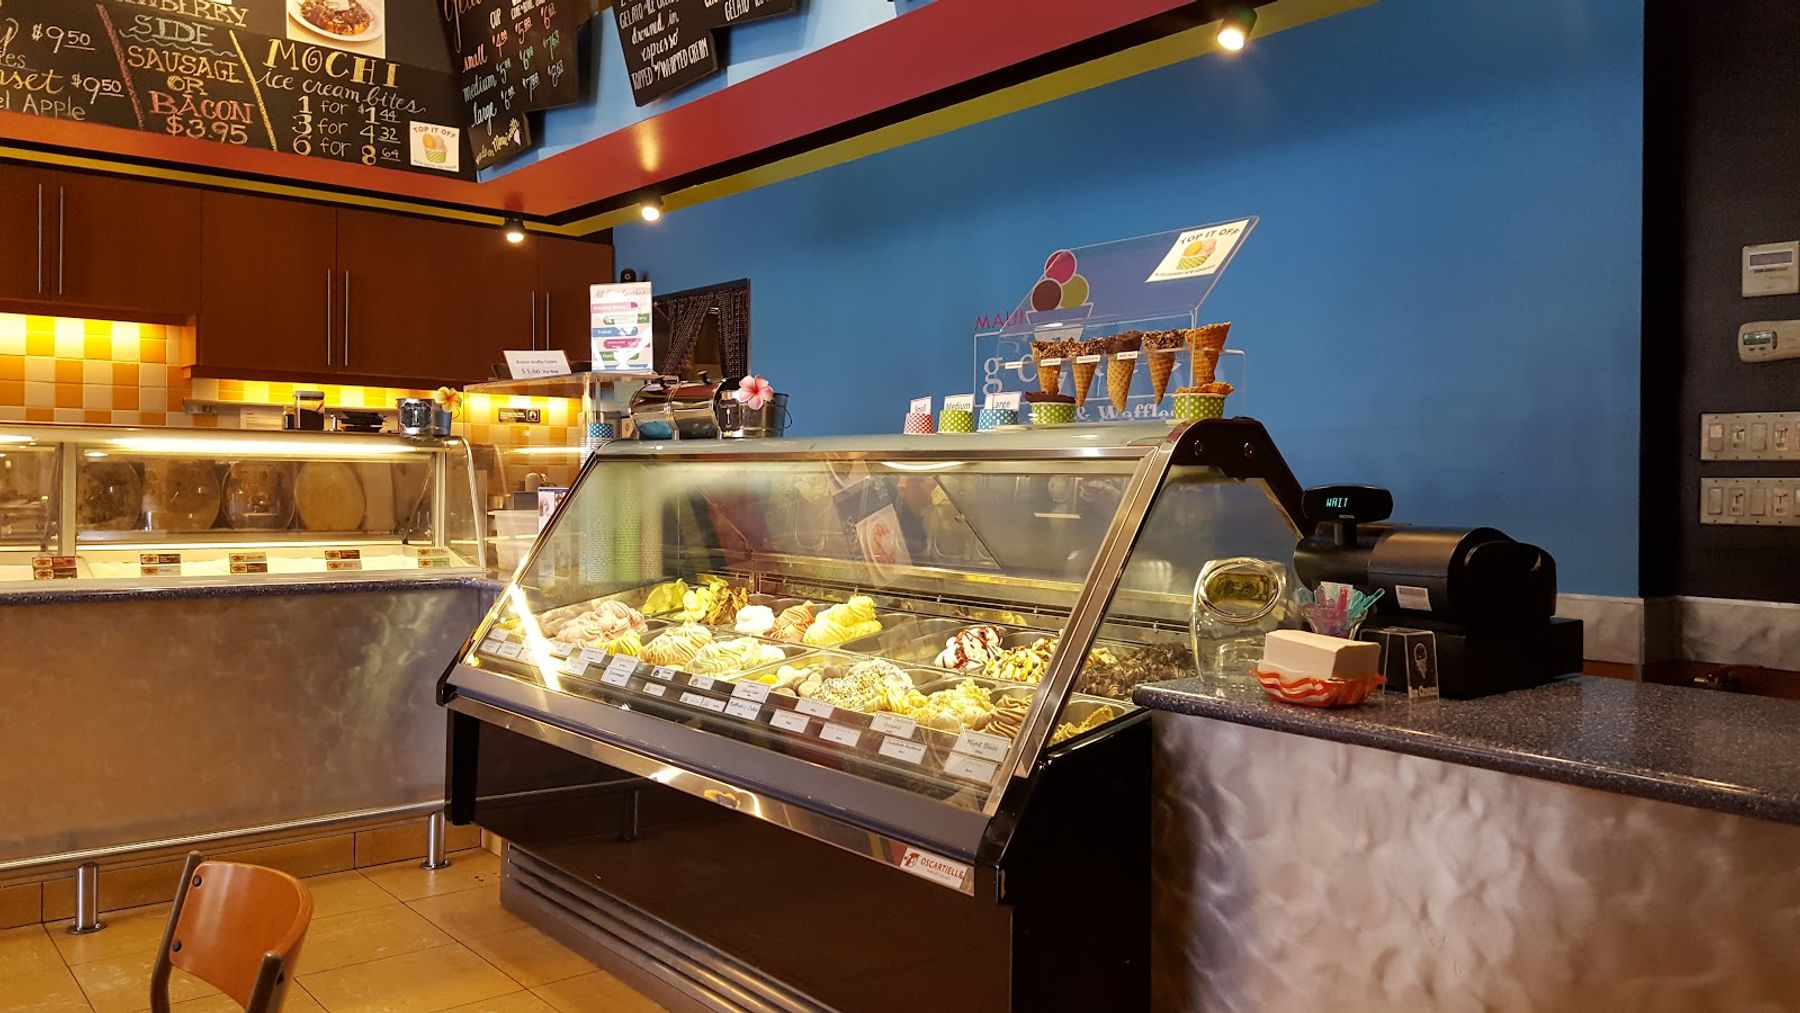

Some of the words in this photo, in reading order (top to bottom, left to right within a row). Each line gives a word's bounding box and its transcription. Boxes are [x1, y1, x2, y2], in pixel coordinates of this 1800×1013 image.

[128, 14, 215, 46] SIDE
[127, 45, 243, 84] SAUSAGE
[263, 38, 400, 88] MOCHI
[462, 43, 488, 73] small
[687, 37, 709, 65] CREAM
[167, 76, 208, 95] OR
[256, 68, 295, 90] ice
[302, 77, 360, 103] cream
[363, 86, 427, 113] bites
[463, 74, 498, 103] medium
[149, 91, 255, 124] BACON
[320, 100, 350, 115] for
[470, 101, 498, 136] large
[165, 114, 249, 145] $3.95
[292, 113, 312, 136] 3
[317, 118, 349, 135] for
[293, 134, 312, 156] 6
[319, 137, 351, 156] for
[1181, 233, 1203, 245] TOP
[1205, 229, 1218, 238] IT
[1218, 228, 1240, 236] OFF
[974, 310, 1025, 331] MAUI
[946, 402, 971, 410] Medium
[1326, 497, 1349, 508] WAIT
